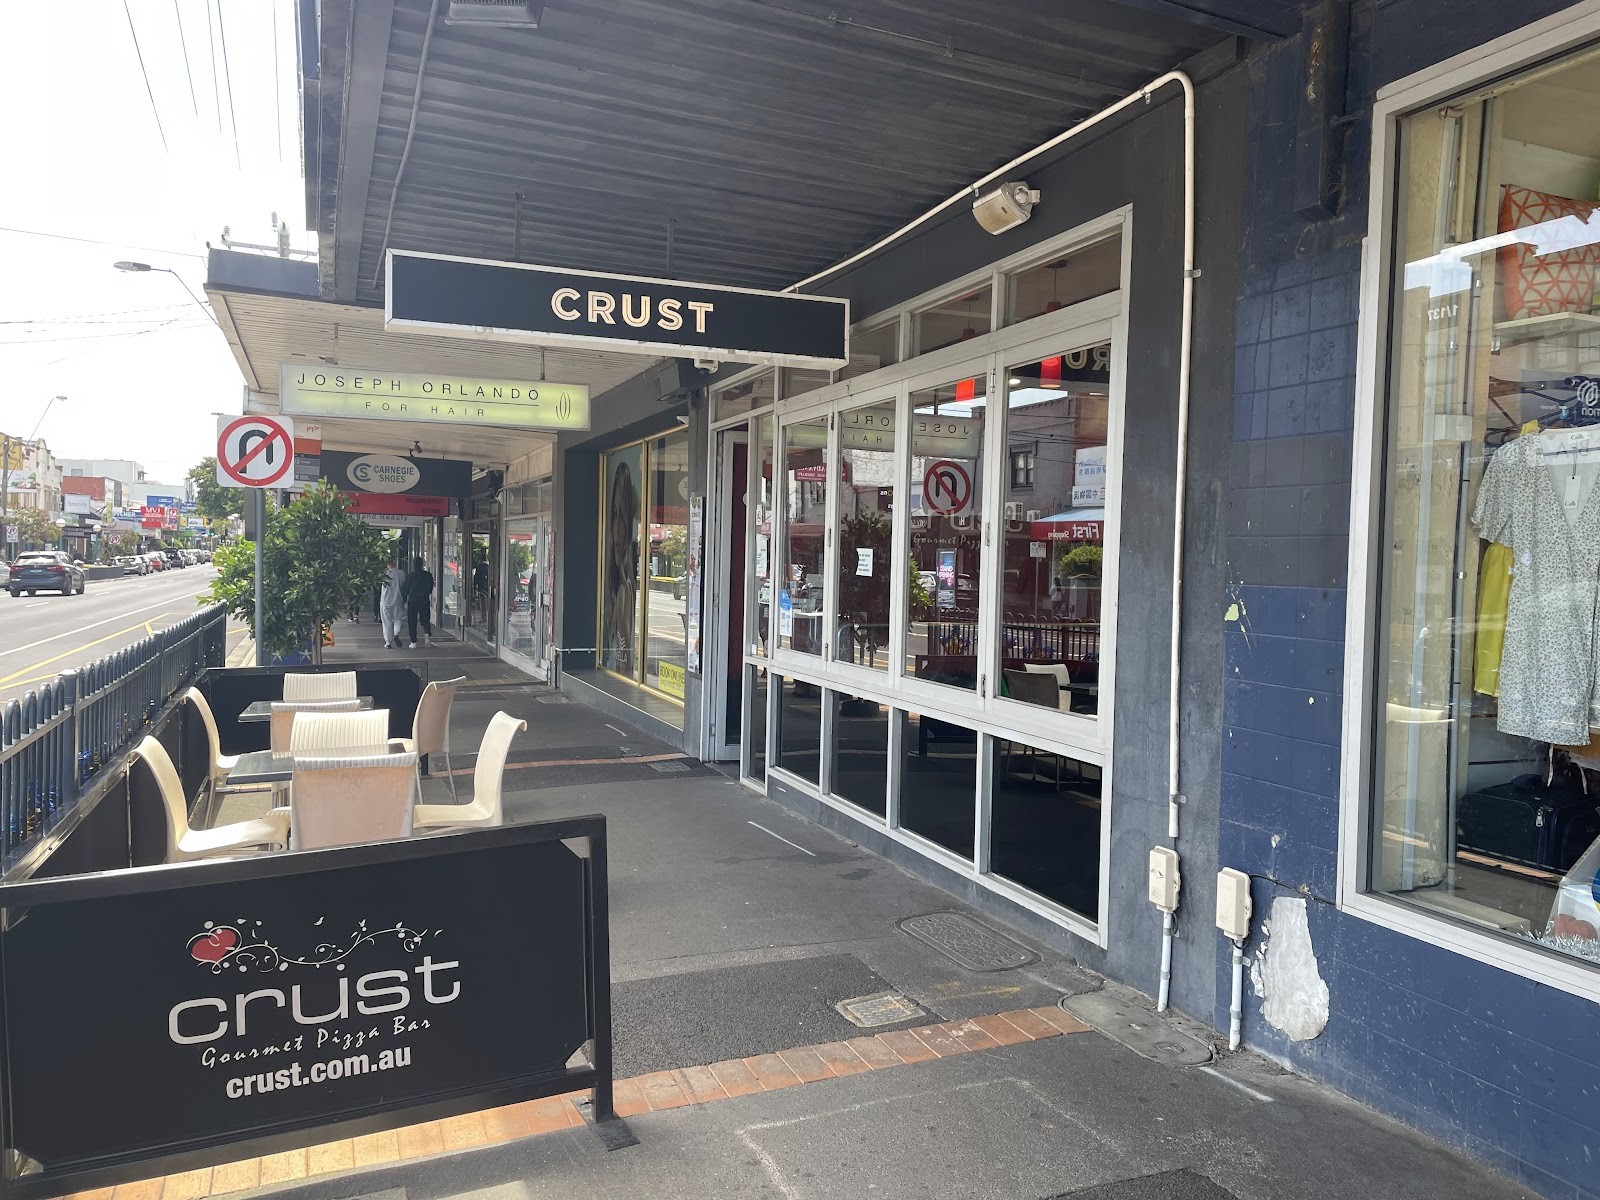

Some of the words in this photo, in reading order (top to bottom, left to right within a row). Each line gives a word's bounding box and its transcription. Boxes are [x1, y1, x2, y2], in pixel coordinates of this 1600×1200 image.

[551, 287, 714, 333] CRUST
[297, 373, 401, 391] JOSEPH
[422, 381, 539, 400] ORLANDO
[365, 401, 408, 411] FOR
[431, 405, 484, 416] HAIR
[374, 465, 415, 476] CARNEGIE
[379, 474, 406, 483] SHOES
[380, 514, 408, 522] Beauty
[168, 955, 460, 1045] crust
[201, 1034, 303, 1068] Gourmet
[316, 1024, 379, 1050] Pizza
[392, 1014, 430, 1035] Bar
[226, 1046, 411, 1099] crust.com.au
